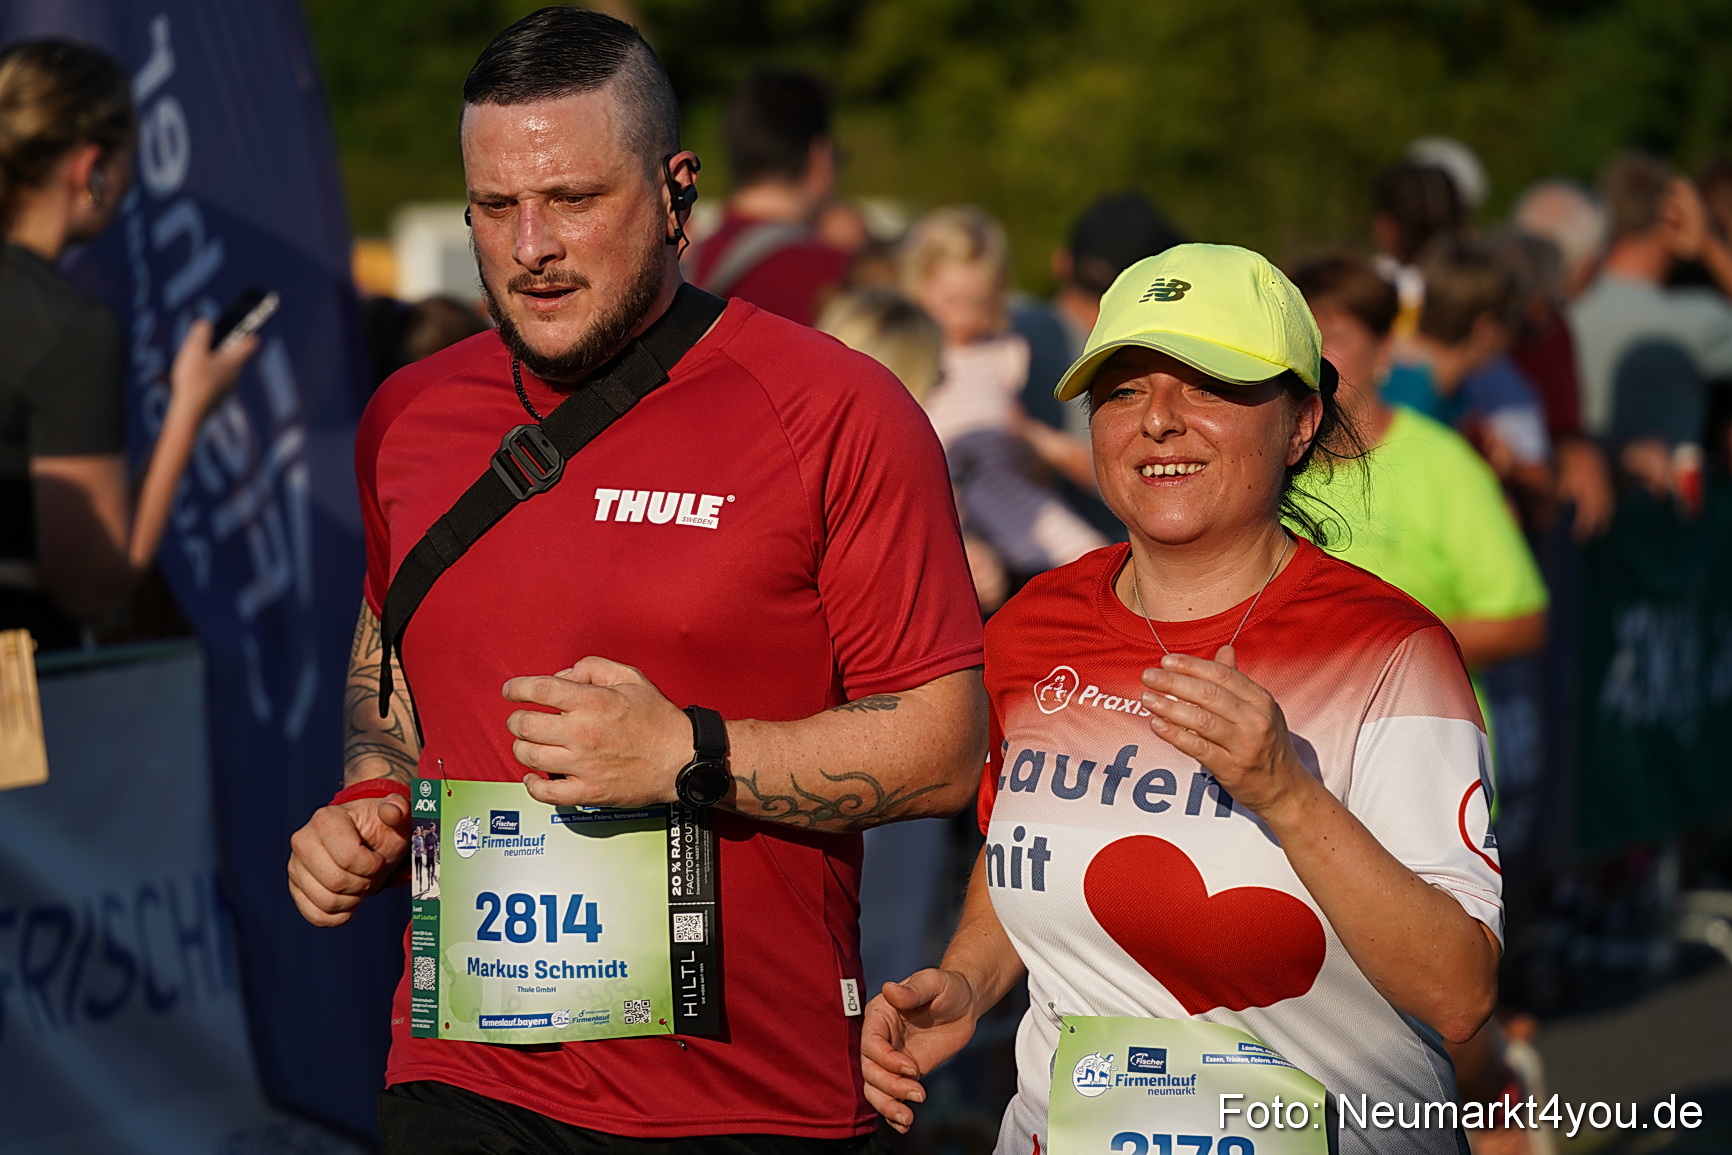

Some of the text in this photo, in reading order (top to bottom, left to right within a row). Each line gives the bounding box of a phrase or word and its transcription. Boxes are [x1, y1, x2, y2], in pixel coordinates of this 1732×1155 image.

[594, 488, 725, 529] THULE
[681, 515, 714, 526] SWEDEN
[414, 799, 437, 812] AOK
[481, 834, 546, 849] Firmenlauf
[504, 847, 545, 857] neumarkt
[684, 808, 694, 896] FACTORY OUTLE
[672, 861, 681, 873] %
[672, 875, 682, 897] 20
[476, 891, 603, 944] 2814
[0, 872, 236, 1042] RISCH
[467, 956, 629, 979] Markus Schmidt
[680, 950, 698, 1017] HILTL
[481, 1017, 548, 1028] firmenlauf.bayern
[572, 1014, 610, 1023] Firmenlauf
[1134, 1057, 1165, 1066] Fischer
[1251, 1056, 1271, 1064] Feiern,
[1115, 1073, 1197, 1087] Firmenlauf
[1147, 1086, 1196, 1096] neumarkt
